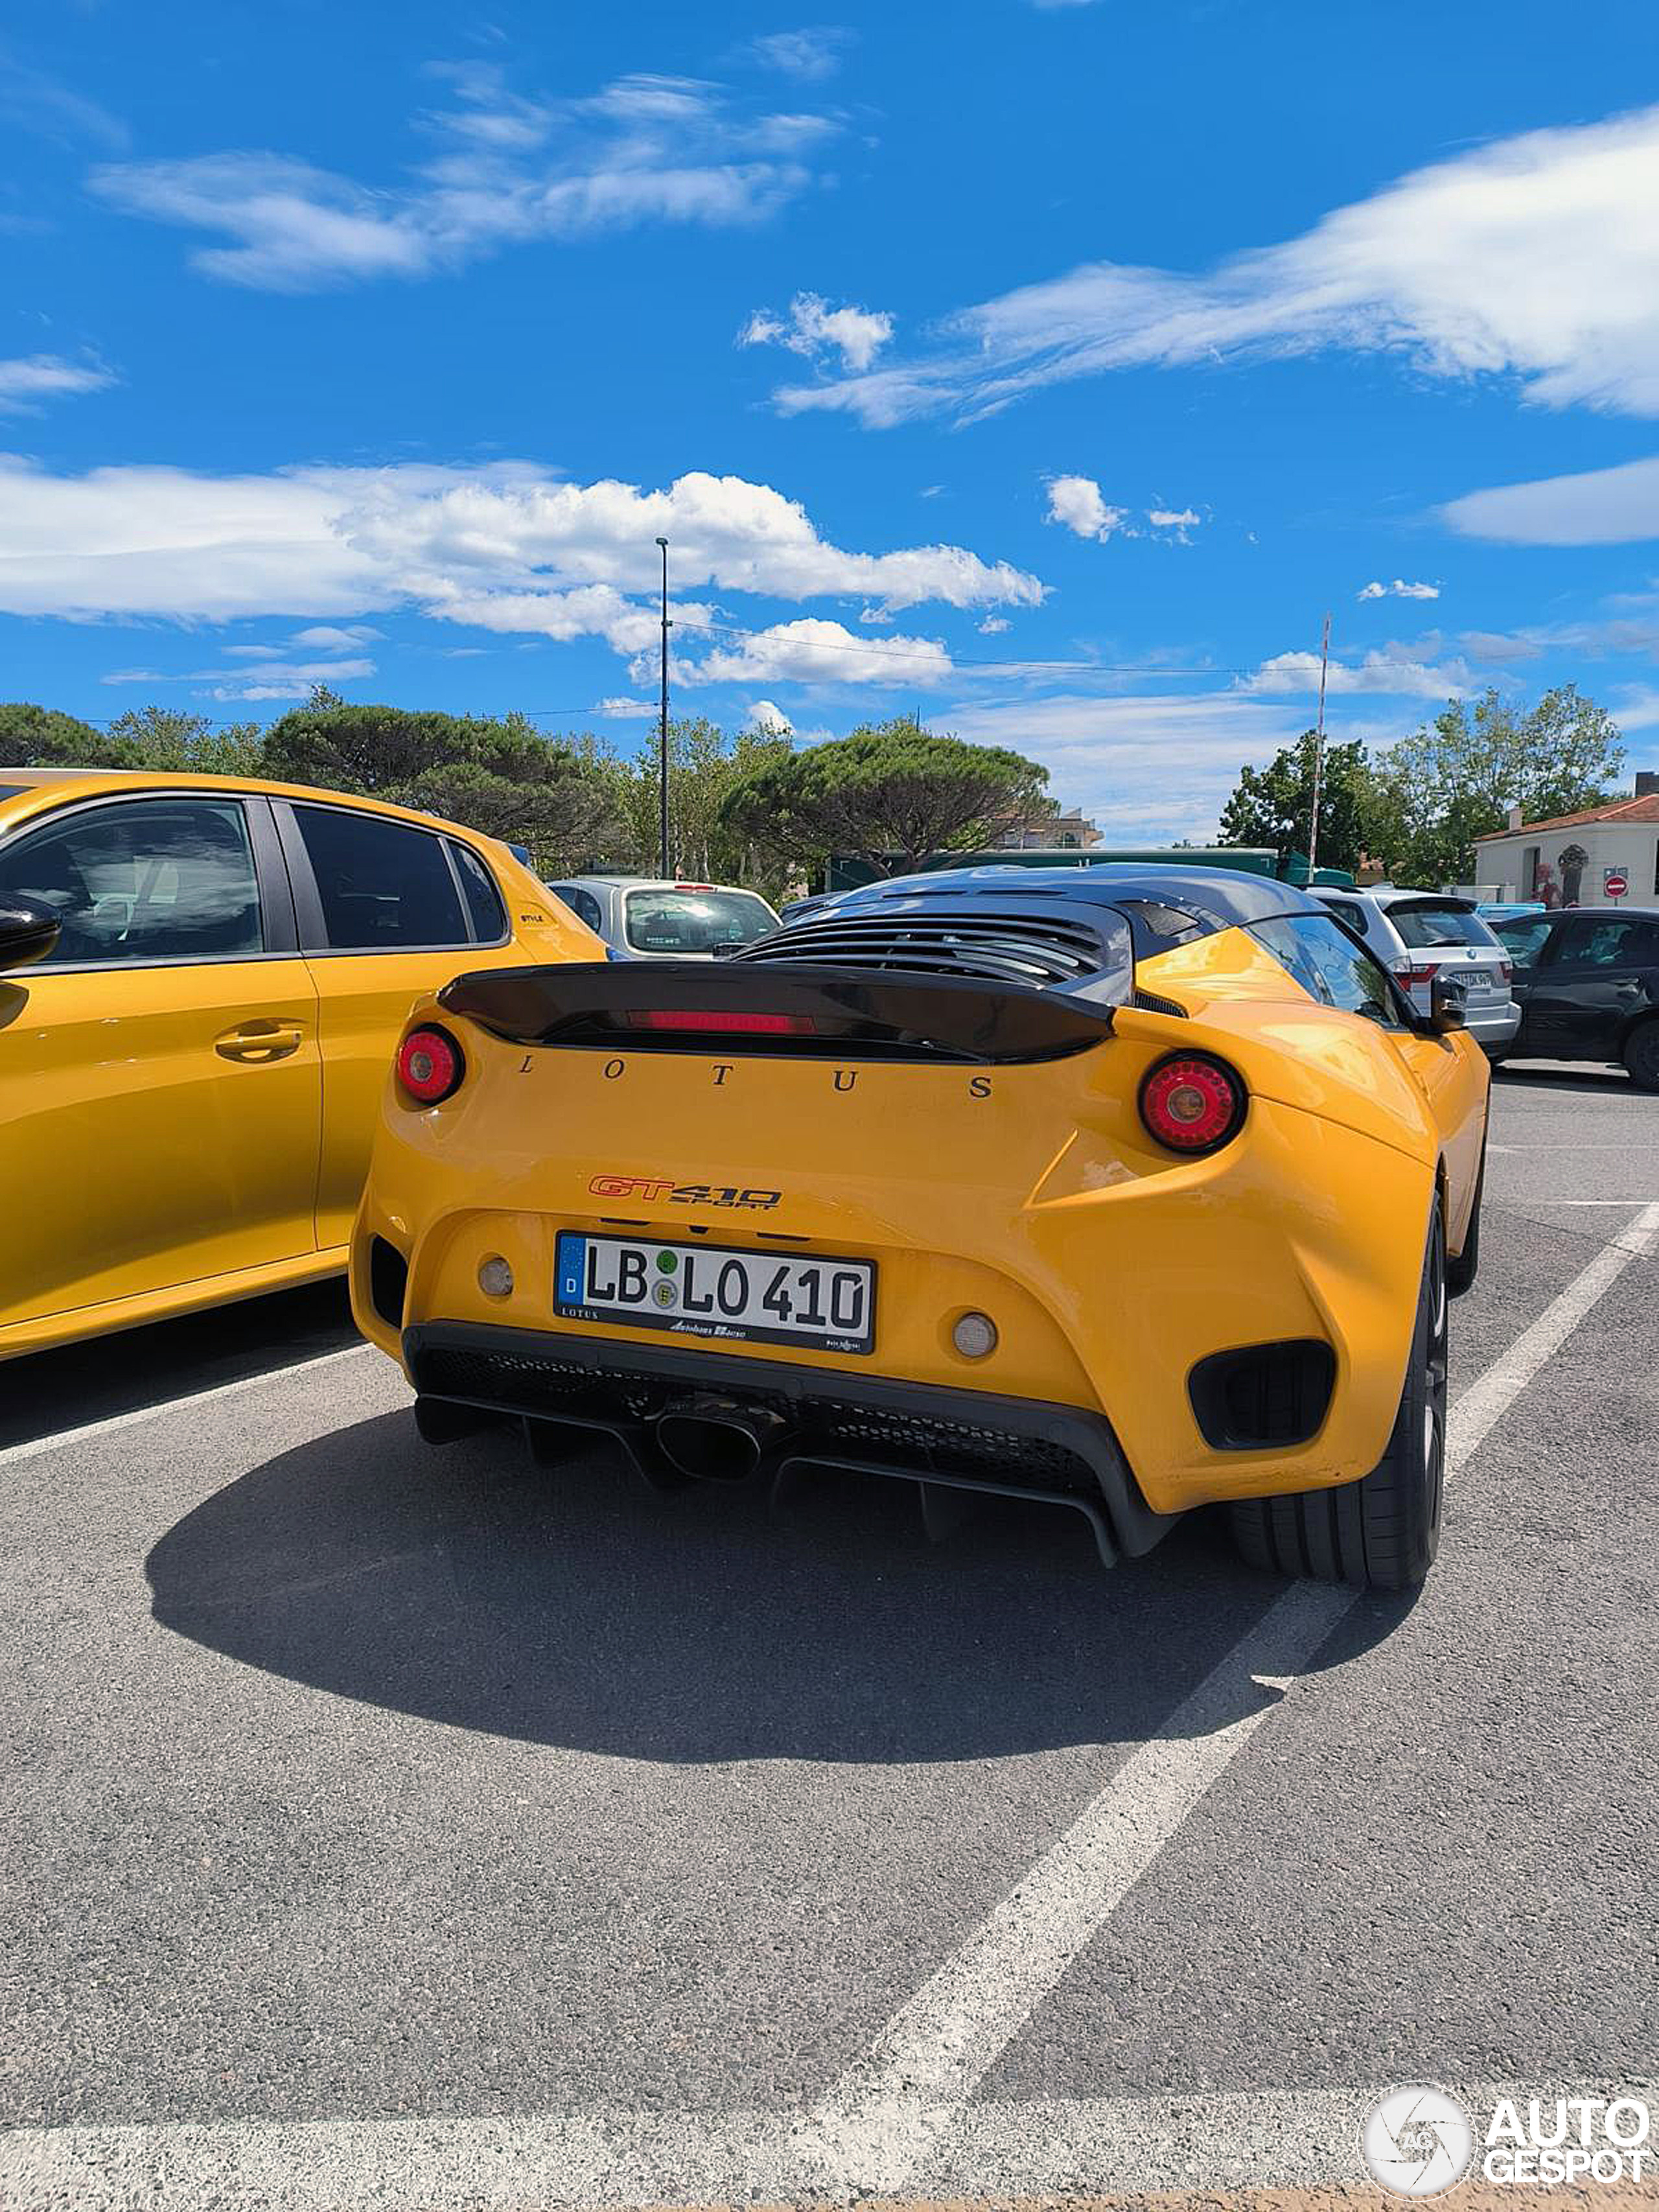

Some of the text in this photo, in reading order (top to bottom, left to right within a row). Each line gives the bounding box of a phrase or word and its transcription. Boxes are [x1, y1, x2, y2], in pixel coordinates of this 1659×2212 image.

[518, 1054, 992, 1099] LOTUS
[667, 1196, 779, 1210] SPORT
[566, 1277, 576, 1293] D
[586, 1246, 864, 1329] LB LO 410
[562, 1307, 598, 1320] LOTUS
